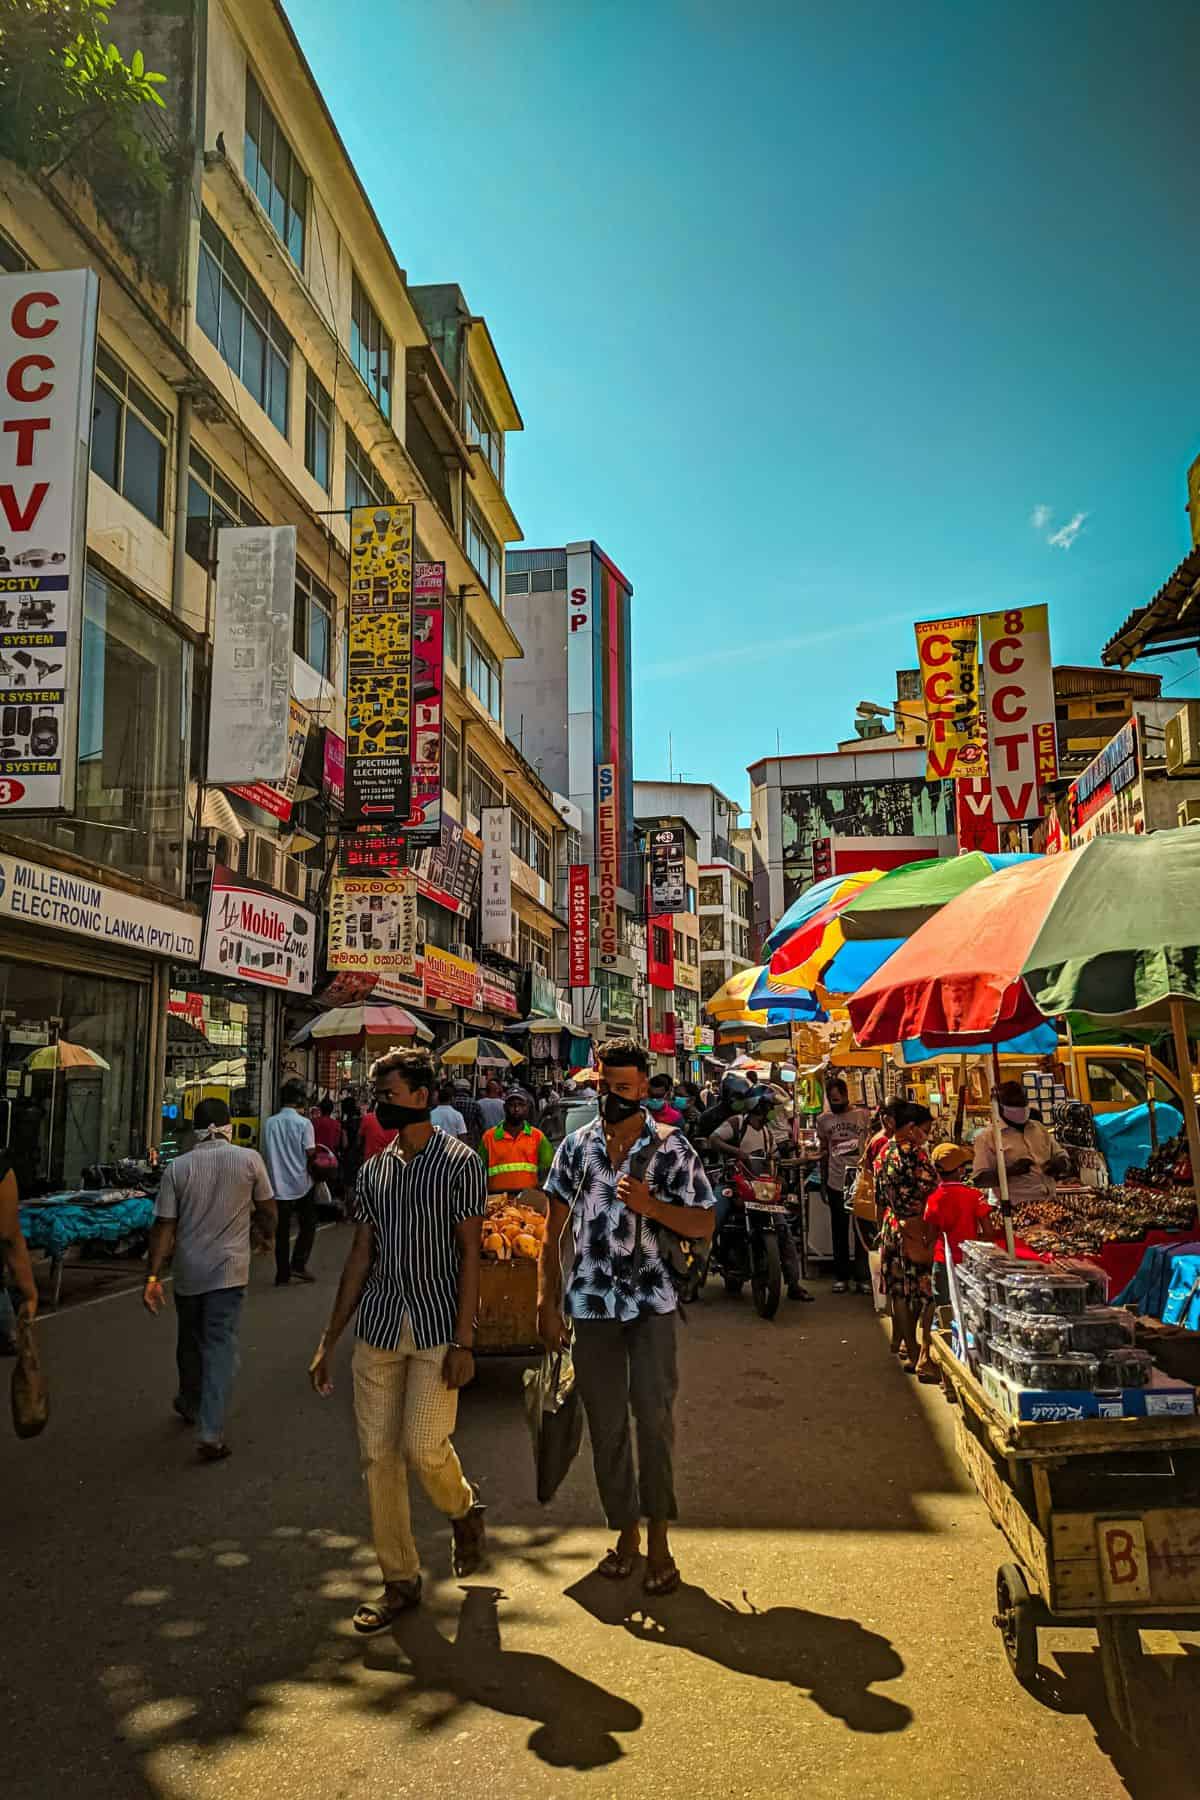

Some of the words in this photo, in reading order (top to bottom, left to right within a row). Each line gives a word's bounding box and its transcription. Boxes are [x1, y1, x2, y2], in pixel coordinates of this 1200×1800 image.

[0, 291, 60, 533] CCTV
[3, 635, 54, 645] SYSTEM
[916, 622, 941, 634] CCTV
[942, 618, 977, 631] CENTRE
[1003, 609, 1025, 635] 8
[9, 692, 60, 703] SYSTEM
[960, 672, 975, 694] 8
[921, 634, 958, 778] CCTV
[988, 637, 1034, 821] CCTV
[6, 761, 57, 773] SYSTEM
[352, 768, 403, 778] ELECTRONIK
[355, 758, 401, 768] SPECTRUM
[489, 815, 503, 893] MULTI
[14, 865, 101, 909] MILLENNIUM
[600, 806, 615, 954] ELECTRONICS
[11, 891, 101, 932] ELECTRONIC
[105, 916, 144, 943] LANKA
[147, 925, 174, 952] (PVT)
[240, 901, 285, 943] Mobile
[573, 885, 586, 926] BOMBAY
[284, 928, 309, 959] Zone
[572, 930, 587, 971] SWEETS
[427, 954, 447, 977] Multi
[1031, 1406, 1083, 1422] Relish
[1105, 1529, 1138, 1585] B
